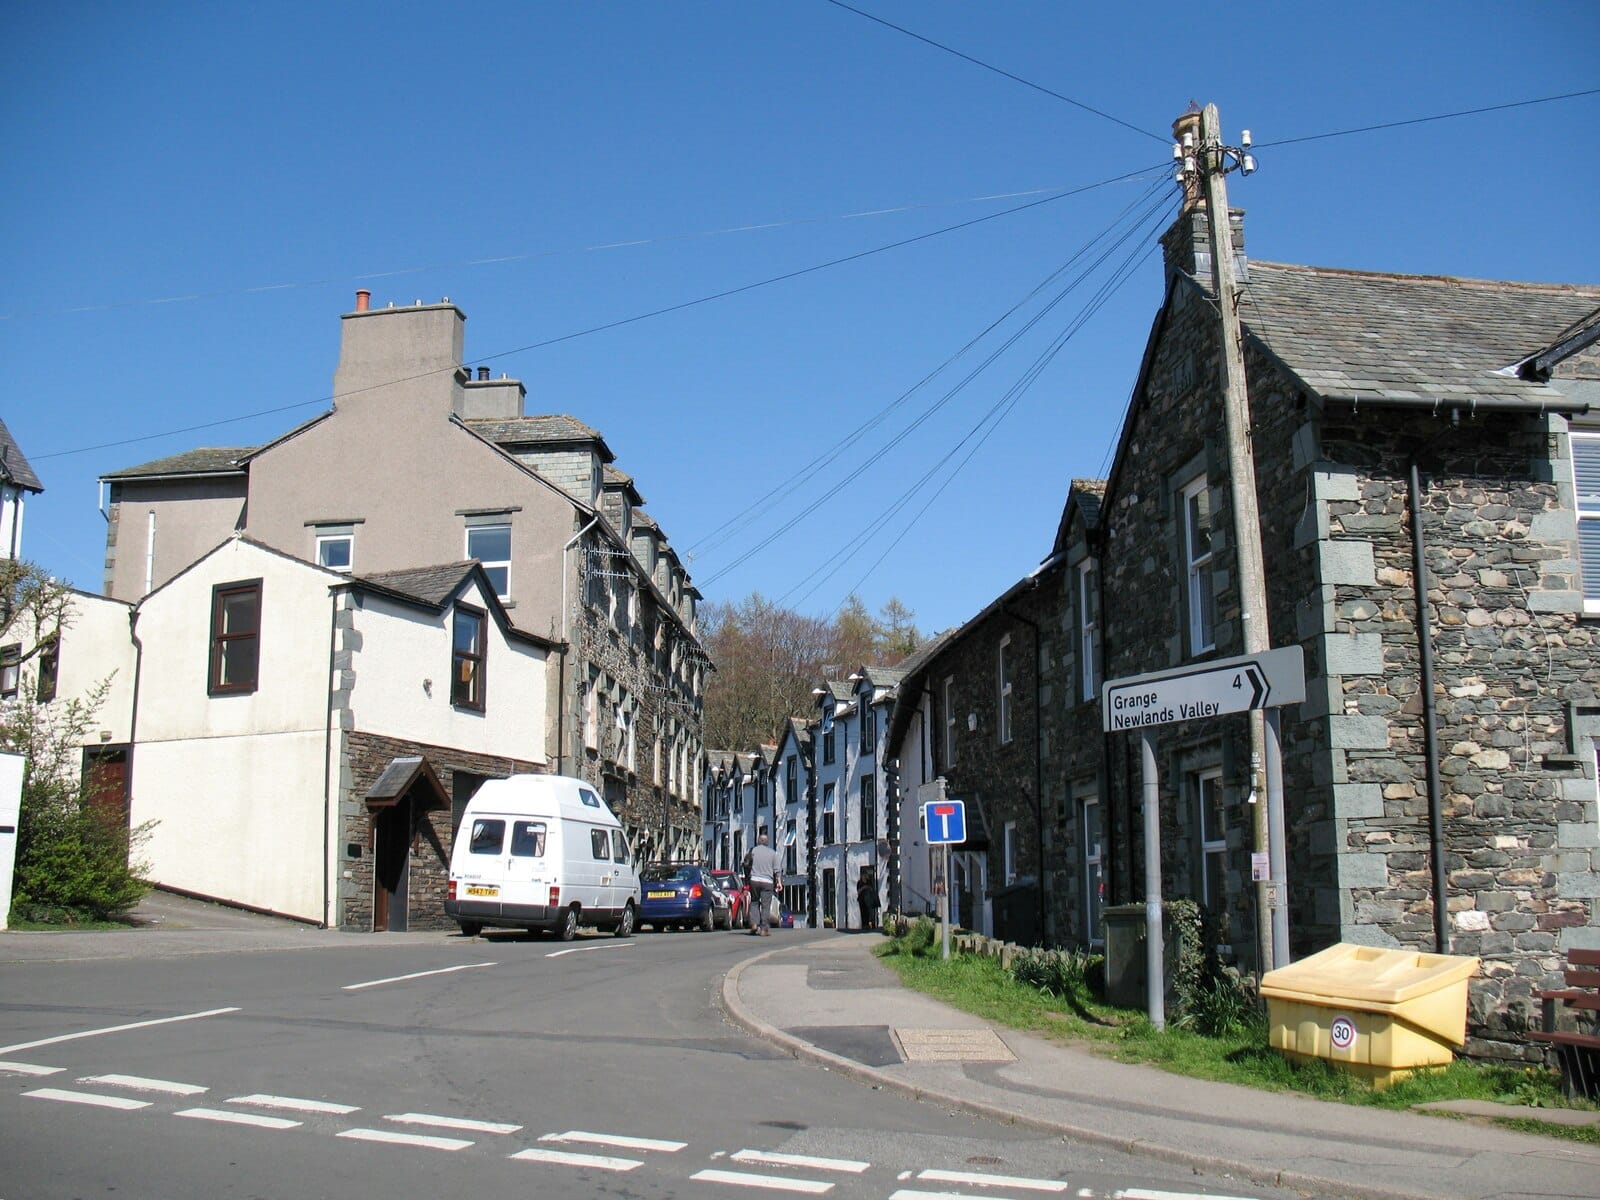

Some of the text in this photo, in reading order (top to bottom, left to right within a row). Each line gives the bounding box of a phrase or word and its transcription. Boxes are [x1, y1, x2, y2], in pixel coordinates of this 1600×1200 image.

[1232, 674, 1242, 690] 4
[1114, 692, 1158, 710] Grange
[1114, 701, 1220, 729] Newlands Valley
[1334, 1025, 1350, 1040] 30
